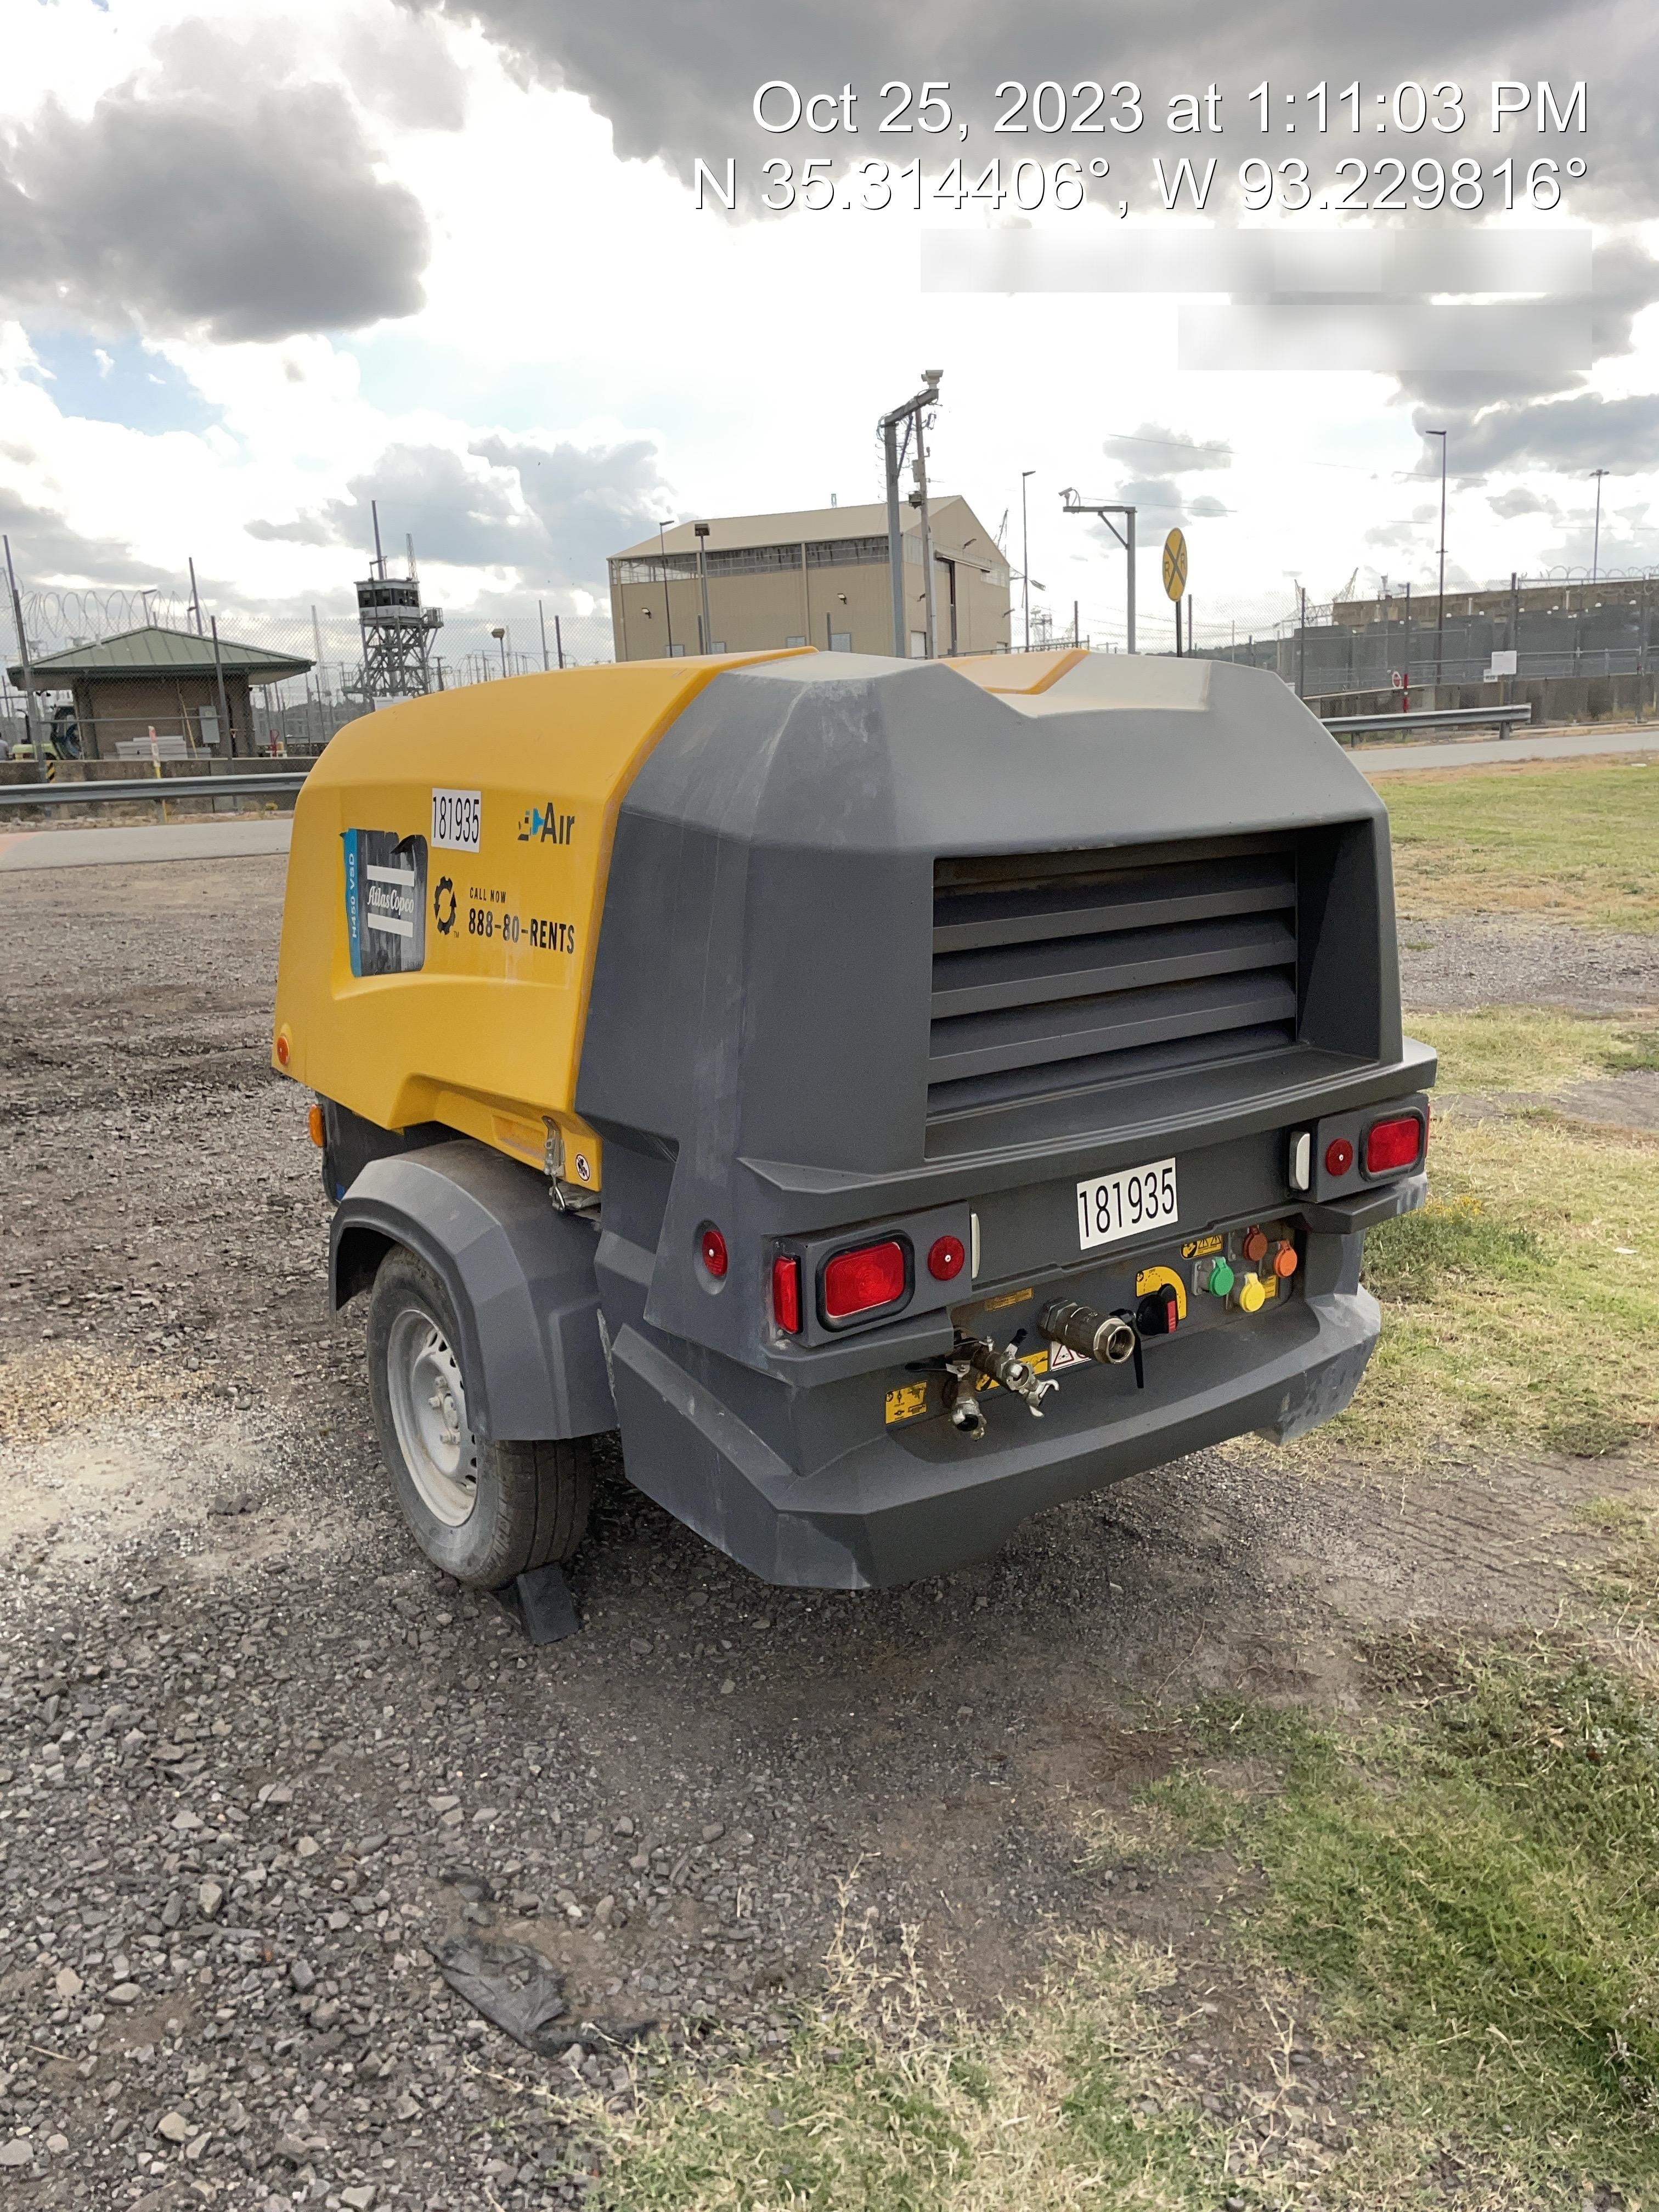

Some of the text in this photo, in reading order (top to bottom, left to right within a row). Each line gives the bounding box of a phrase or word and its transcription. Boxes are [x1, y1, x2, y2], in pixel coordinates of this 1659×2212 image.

[432, 796, 479, 844] 181935
[470, 887, 506, 904] CALL NOW
[469, 908, 575, 955] 888-80-RENTS
[1080, 1167, 1174, 1237] 181935
